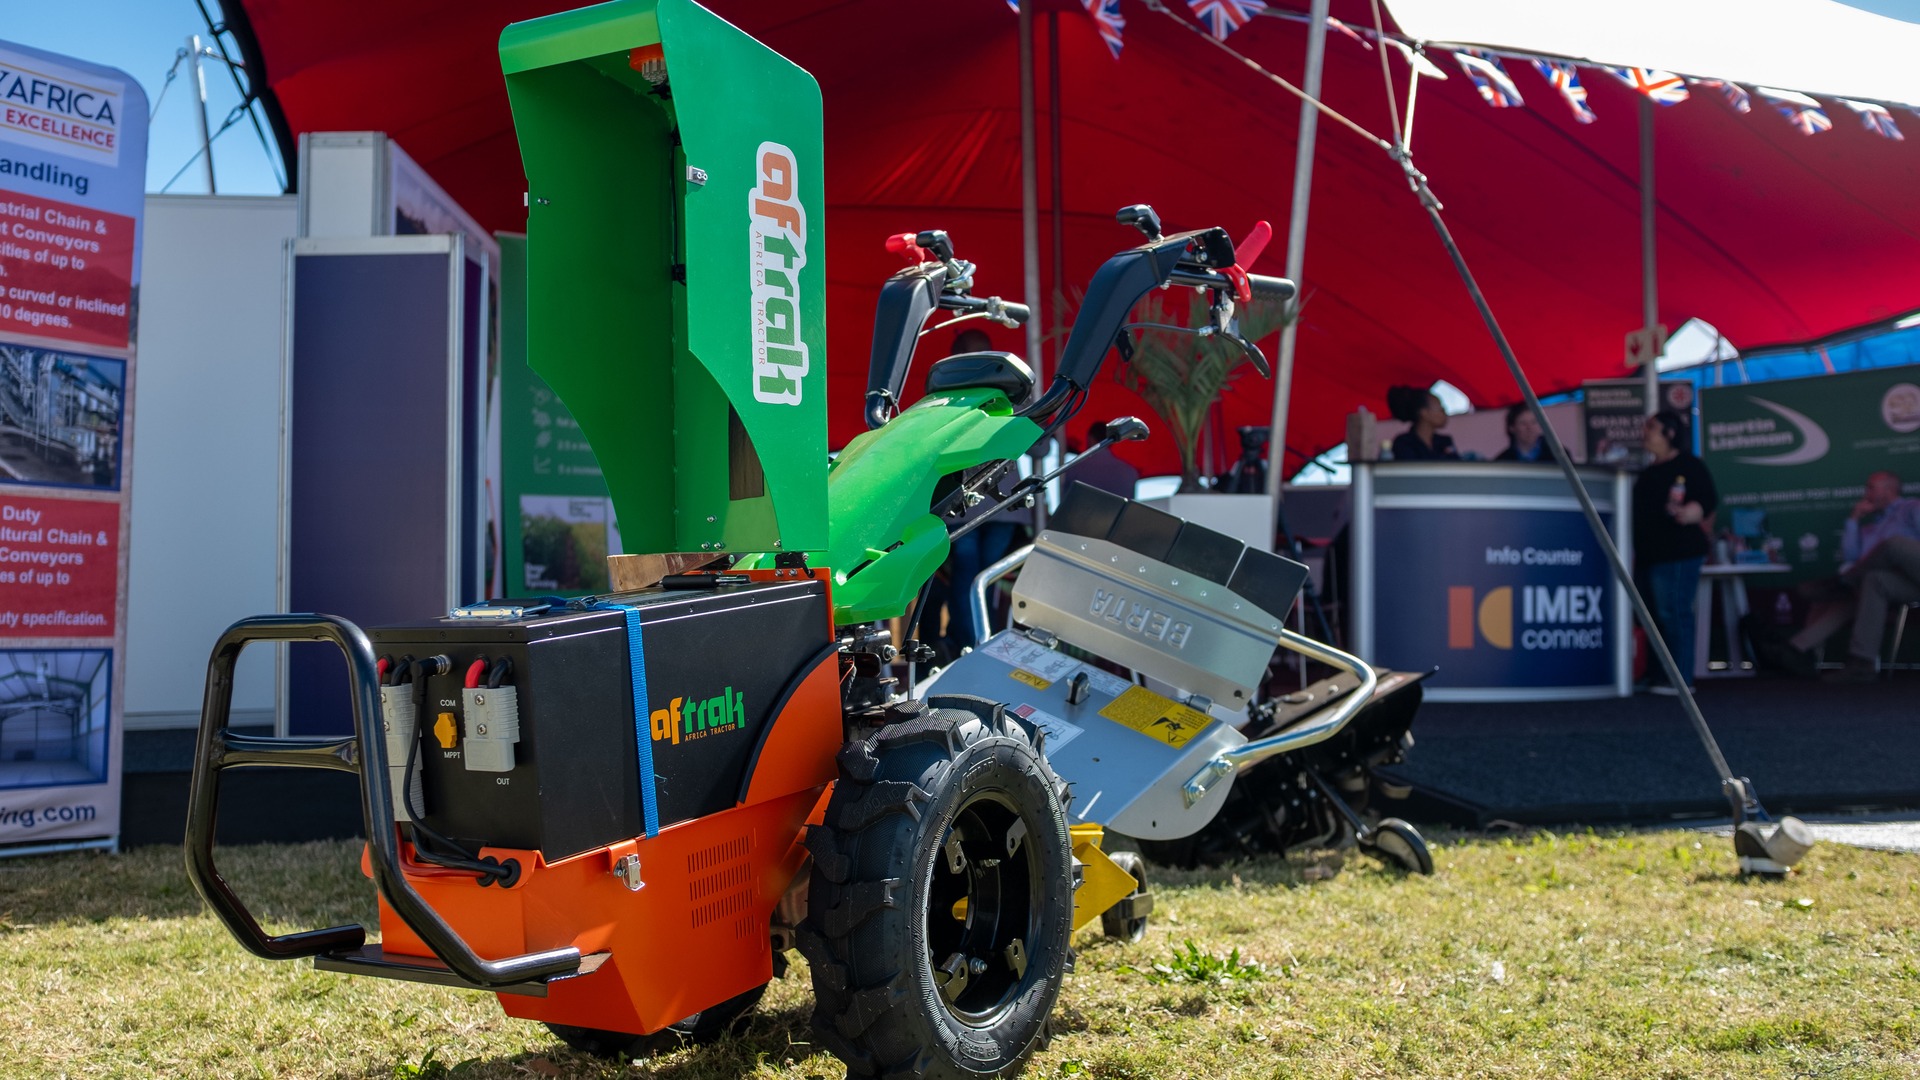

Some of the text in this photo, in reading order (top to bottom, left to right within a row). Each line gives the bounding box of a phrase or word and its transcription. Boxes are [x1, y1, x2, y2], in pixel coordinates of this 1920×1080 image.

[6, 108, 115, 148] EXCELLENCE
[0, 158, 89, 194] andling
[44, 209, 91, 231] Chain
[95, 219, 107, 235] &
[12, 223, 101, 253] Conveyors
[34, 248, 49, 263] of
[51, 254, 68, 270] up
[71, 255, 85, 270] to
[755, 151, 804, 396] aftrak
[8, 286, 55, 306] curved
[58, 295, 72, 308] or
[75, 294, 126, 317] inclined
[755, 230, 766, 366] AFRICA TRACTOR
[14, 305, 73, 329] degrees.
[3, 505, 41, 526] Duty
[47, 528, 92, 545] Chain
[96, 530, 108, 546] &
[0, 546, 84, 568] Conveyors
[1485, 545, 1583, 565] Info Counter
[19, 568, 34, 584] of
[36, 572, 53, 588] up
[56, 570, 70, 585] to
[1523, 586, 1602, 623] IMEX
[22, 609, 108, 628] specification.
[1089, 588, 1193, 649] BERTA
[1521, 628, 1602, 650] connect
[440, 699, 456, 707] COM
[650, 686, 745, 745] aftrak
[684, 723, 736, 742] AFRICA TRACTOR
[444, 751, 460, 759] MPPT
[496, 777, 510, 785] OUT
